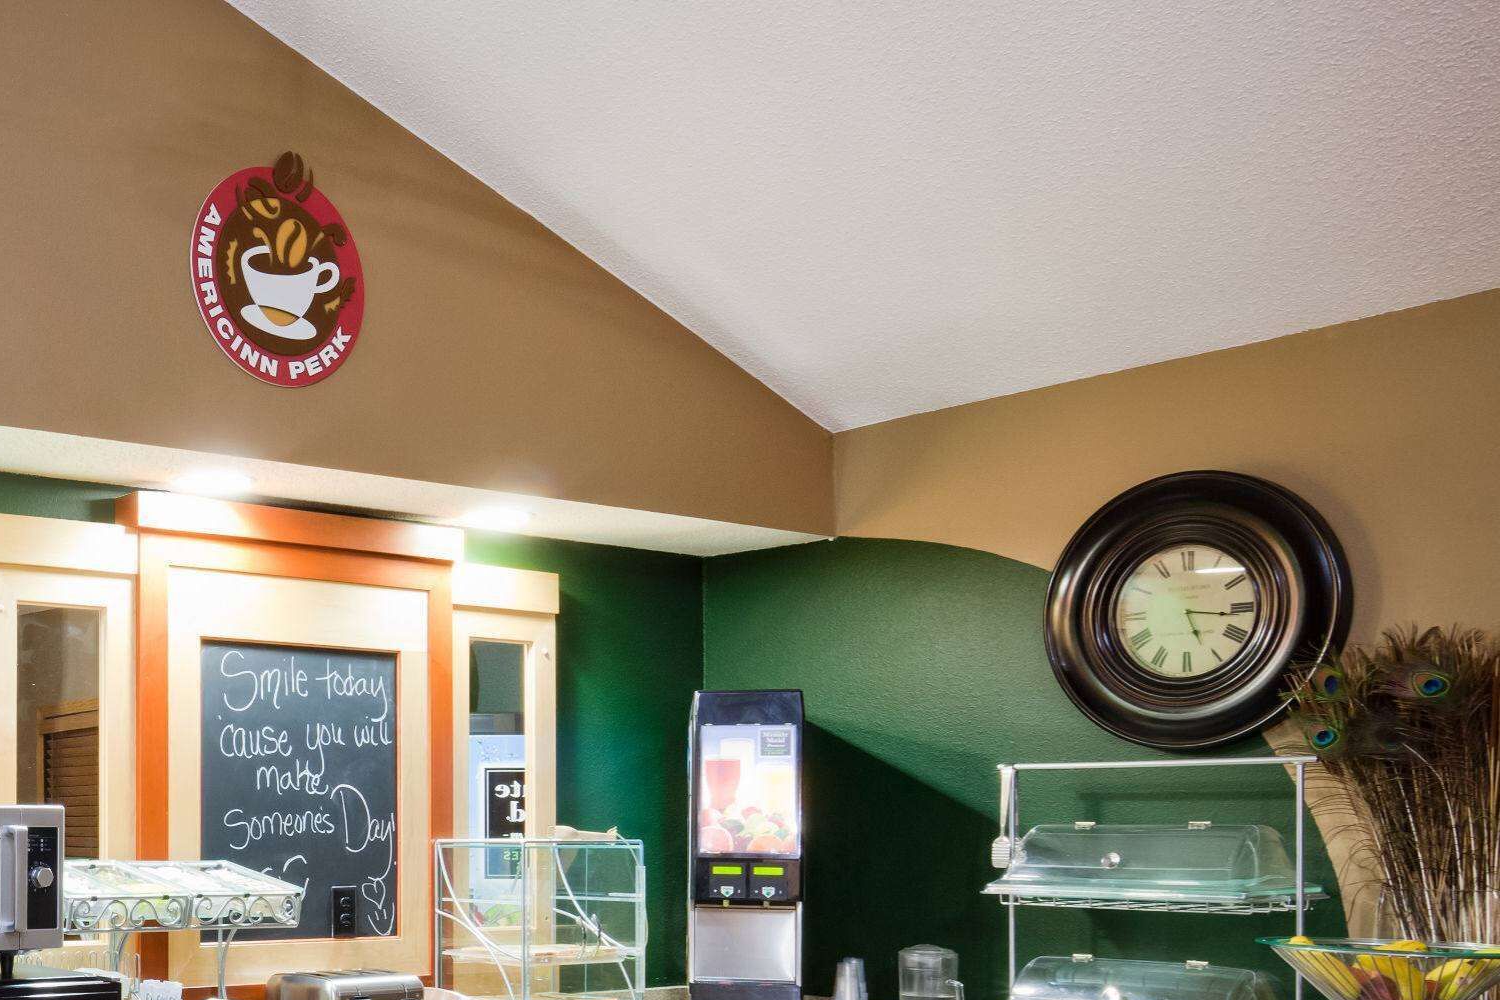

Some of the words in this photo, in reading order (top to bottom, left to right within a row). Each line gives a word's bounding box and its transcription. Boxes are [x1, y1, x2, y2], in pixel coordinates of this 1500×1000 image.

[197, 203, 279, 377] AMERICINN
[288, 325, 352, 379] PERK
[221, 650, 308, 711] Smile
[315, 658, 388, 722] today
[257, 759, 329, 795] make
[306, 722, 346, 777] you
[354, 716, 393, 747] will
[223, 806, 335, 850] Someone's
